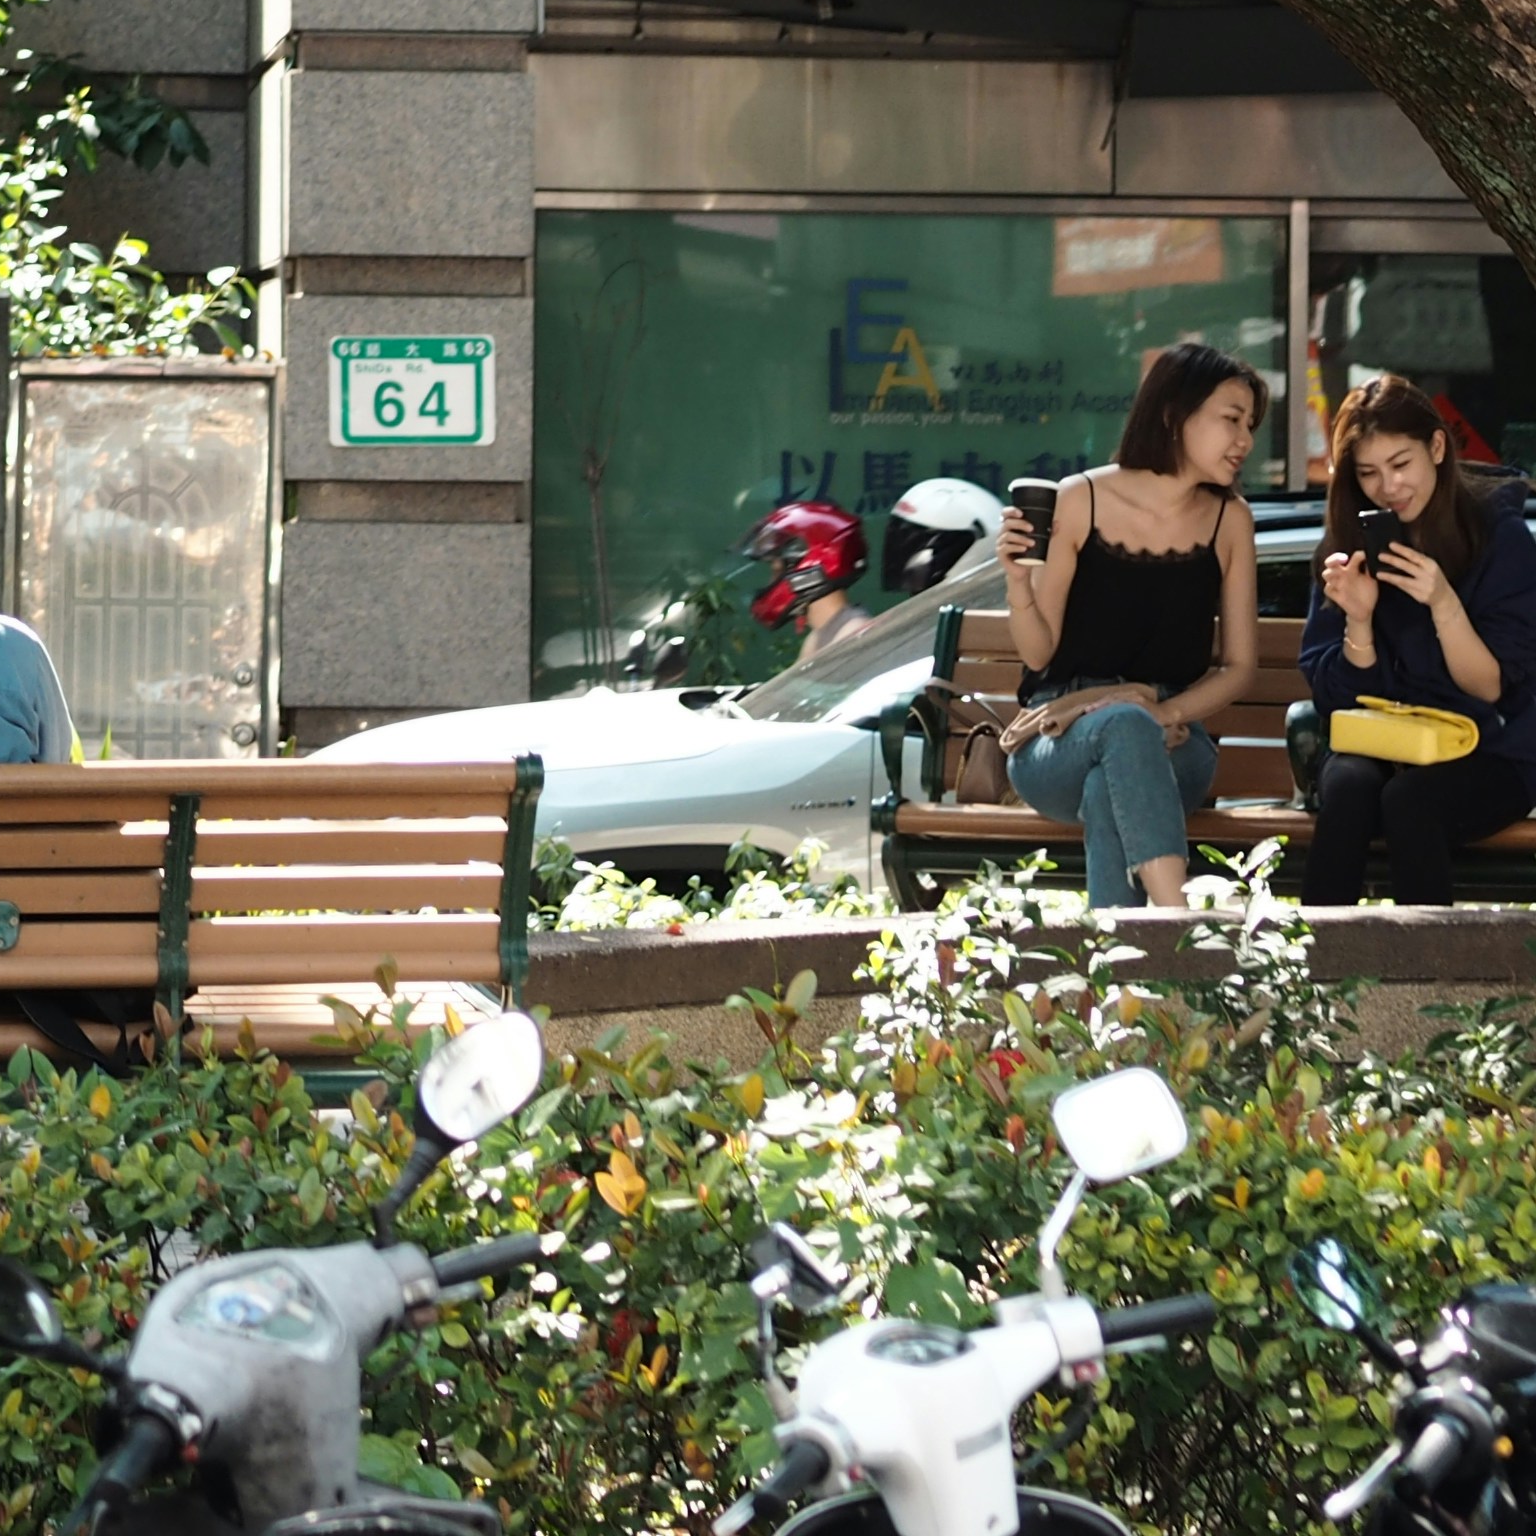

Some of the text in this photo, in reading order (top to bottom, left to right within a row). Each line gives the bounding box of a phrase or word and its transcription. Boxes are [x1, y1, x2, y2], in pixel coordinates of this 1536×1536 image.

[338, 342, 361, 356] 66
[463, 342, 486, 356] 62
[373, 380, 450, 427] 64
[830, 412, 855, 424] our
